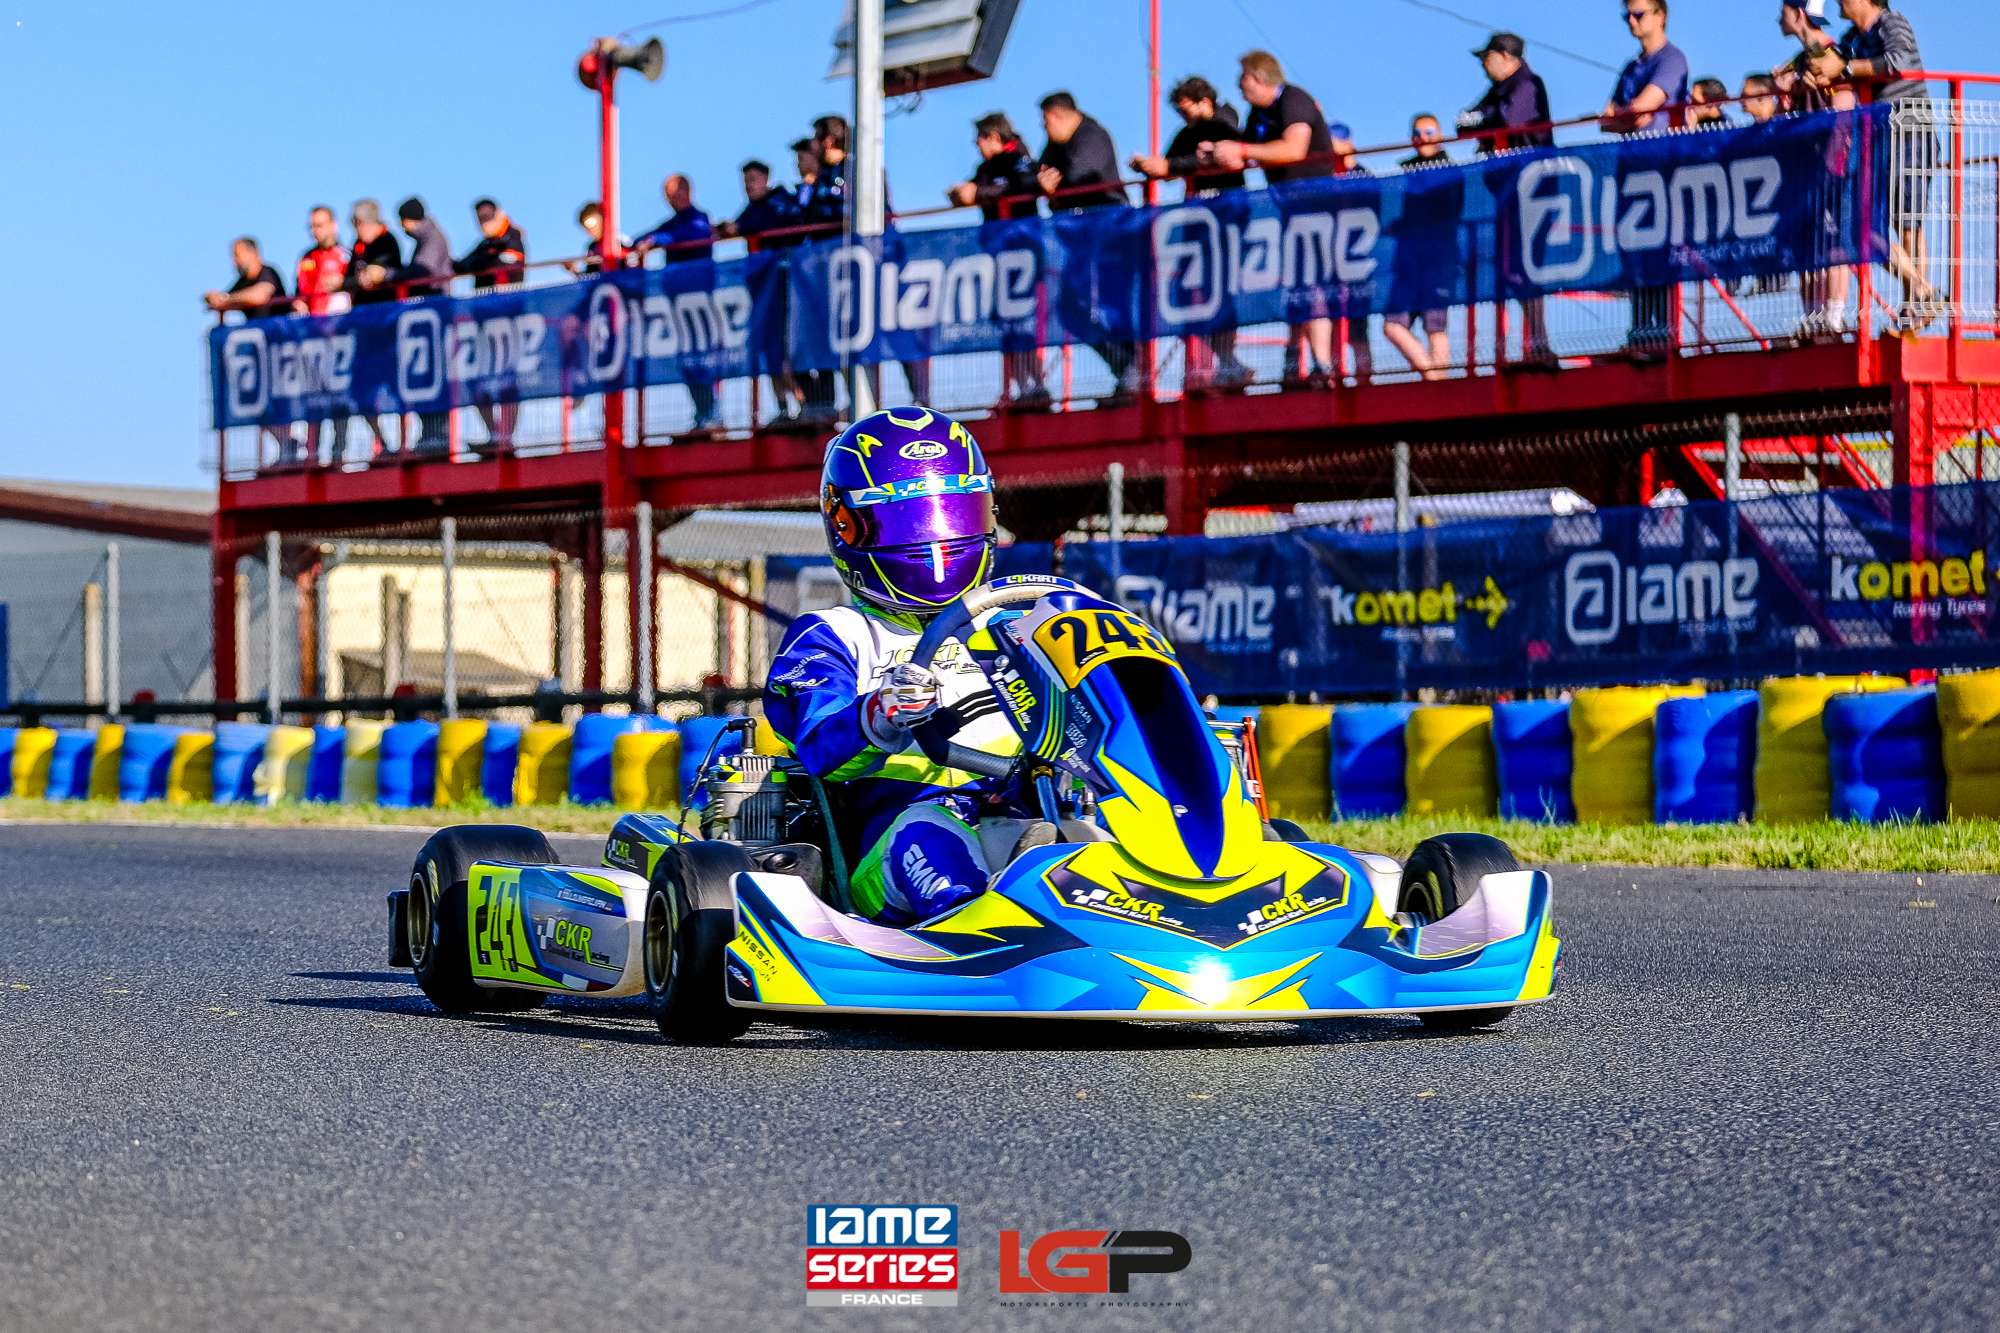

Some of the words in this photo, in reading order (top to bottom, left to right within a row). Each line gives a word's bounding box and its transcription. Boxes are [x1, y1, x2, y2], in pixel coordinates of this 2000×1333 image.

[1831, 550, 1986, 601] komet
[1331, 581, 1457, 626] komet
[1007, 679, 1038, 715] CKR
[475, 876, 518, 972] 243
[1105, 893, 1165, 922] CKR
[1261, 893, 1309, 920] CKR
[555, 919, 593, 965] CKR
[739, 931, 778, 975] NISSAN
